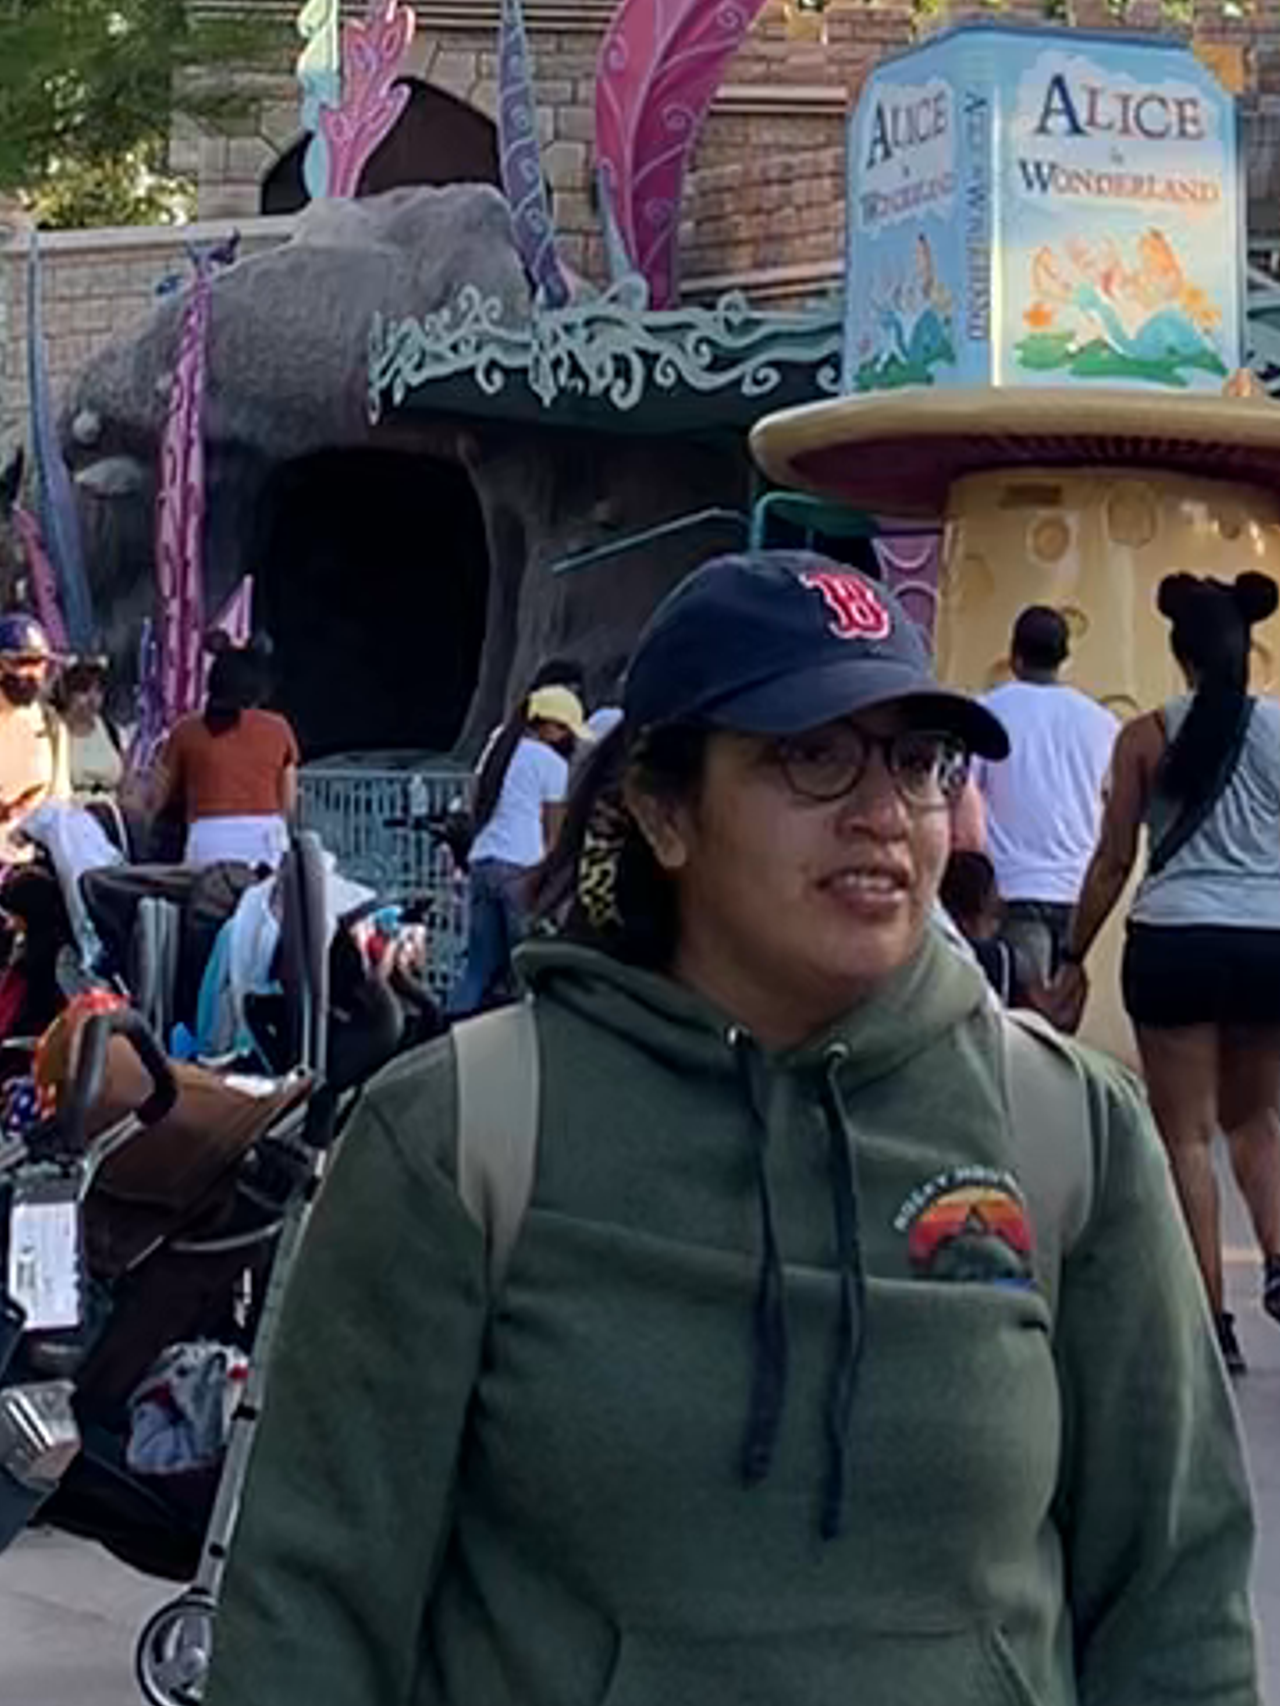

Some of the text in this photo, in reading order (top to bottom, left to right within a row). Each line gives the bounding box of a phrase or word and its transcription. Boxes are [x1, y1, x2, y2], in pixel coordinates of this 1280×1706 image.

[867, 91, 947, 170] ALICE
[1034, 72, 1206, 141] ALICE
[1018, 158, 1221, 203] WONDERLAND
[798, 571, 888, 639] B
